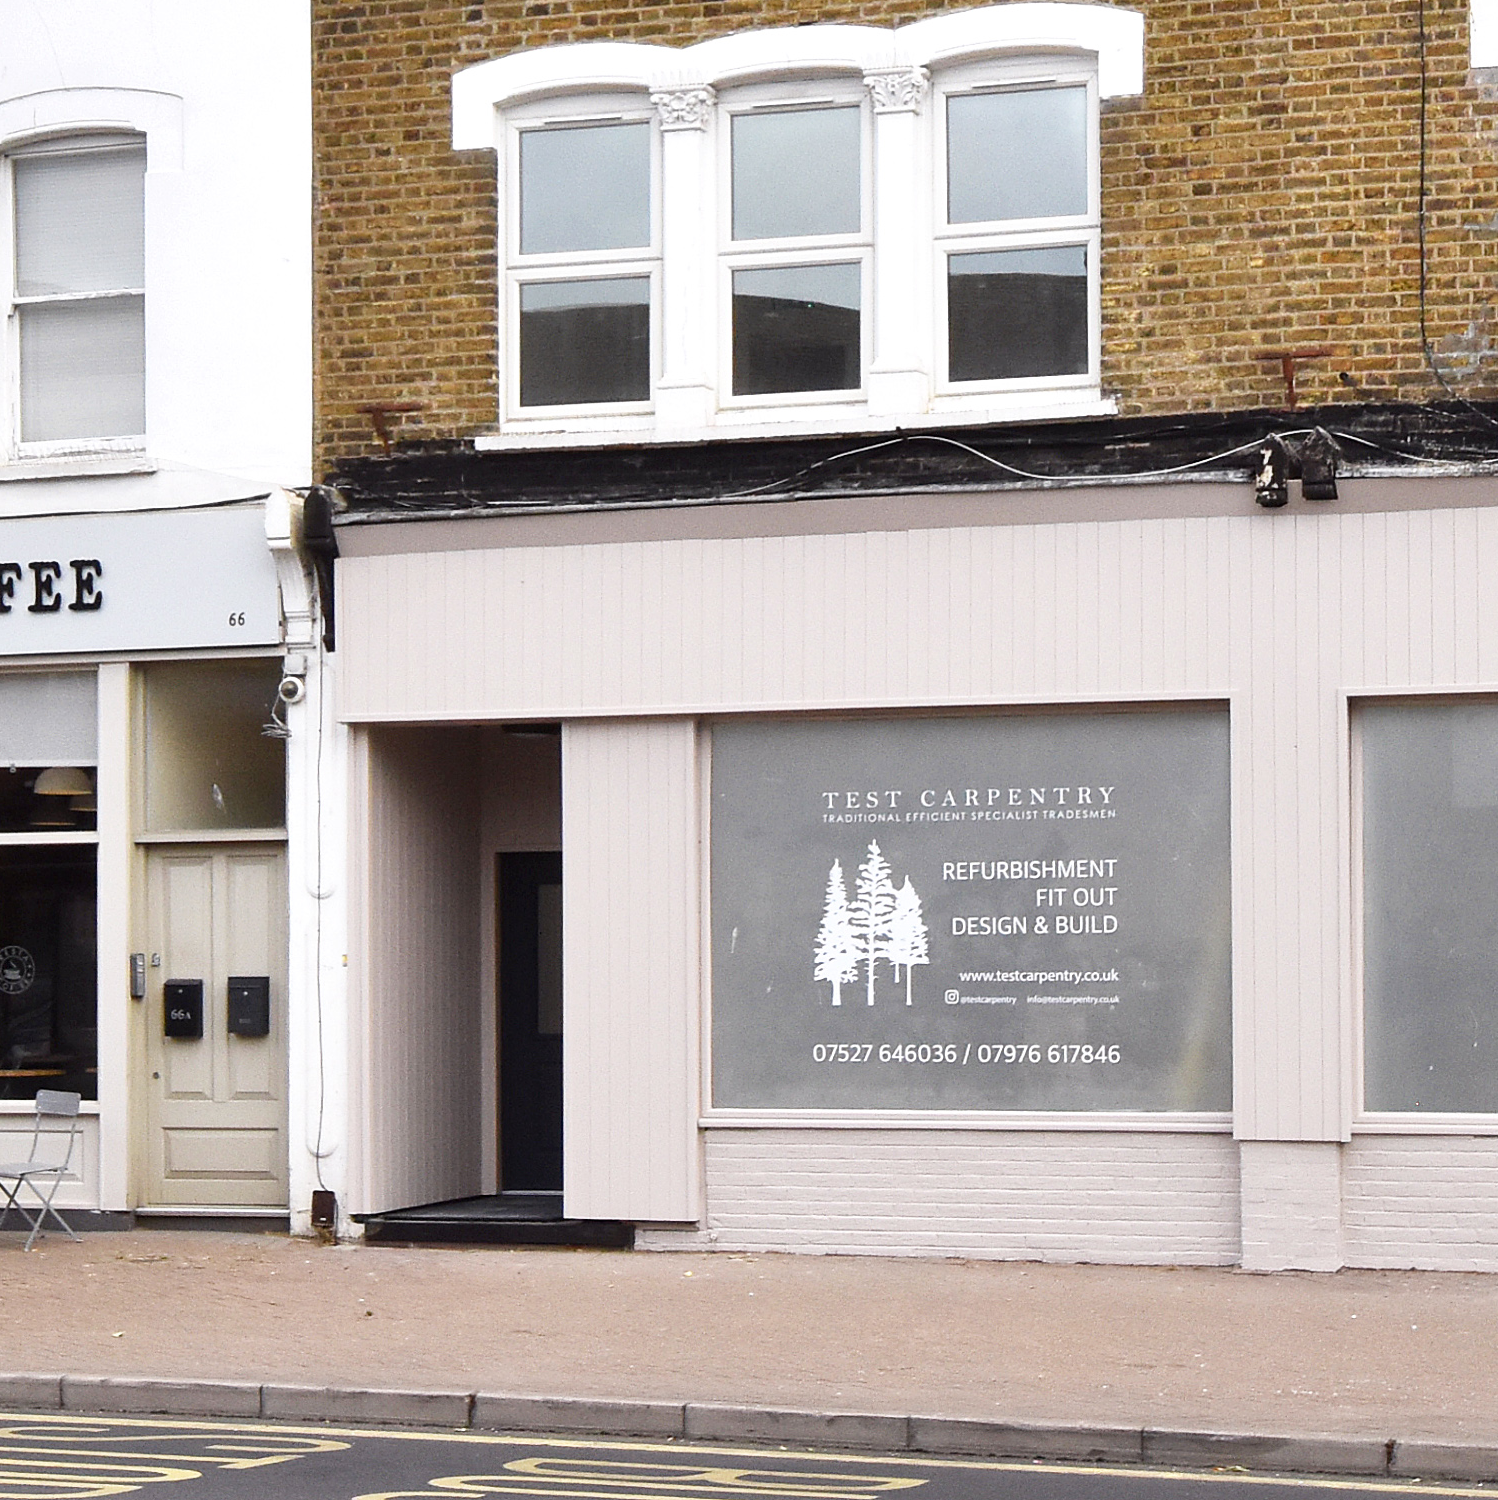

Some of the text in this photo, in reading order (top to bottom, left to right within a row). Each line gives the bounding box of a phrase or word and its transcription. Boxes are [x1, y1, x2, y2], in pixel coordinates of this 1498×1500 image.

[228, 612, 246, 627] 66
[822, 786, 1116, 809] TEST CARPENTRY
[822, 809, 1117, 823] TRADITIONAL EFFICIENT SPECIALIST TRADESMEN
[943, 859, 1118, 880] REFURBISHMENT
[1036, 887, 1118, 907] FIT OUT
[952, 915, 1118, 935] DESIGN & BUILD
[959, 968, 1119, 984] www.testcarpentry.co.uk
[171, 1009, 191, 1020] 66A
[813, 1043, 873, 1062] 07527
[878, 1043, 957, 1063] 646036
[977, 1044, 1041, 1063] 07976
[1047, 1044, 1121, 1064] 617846
